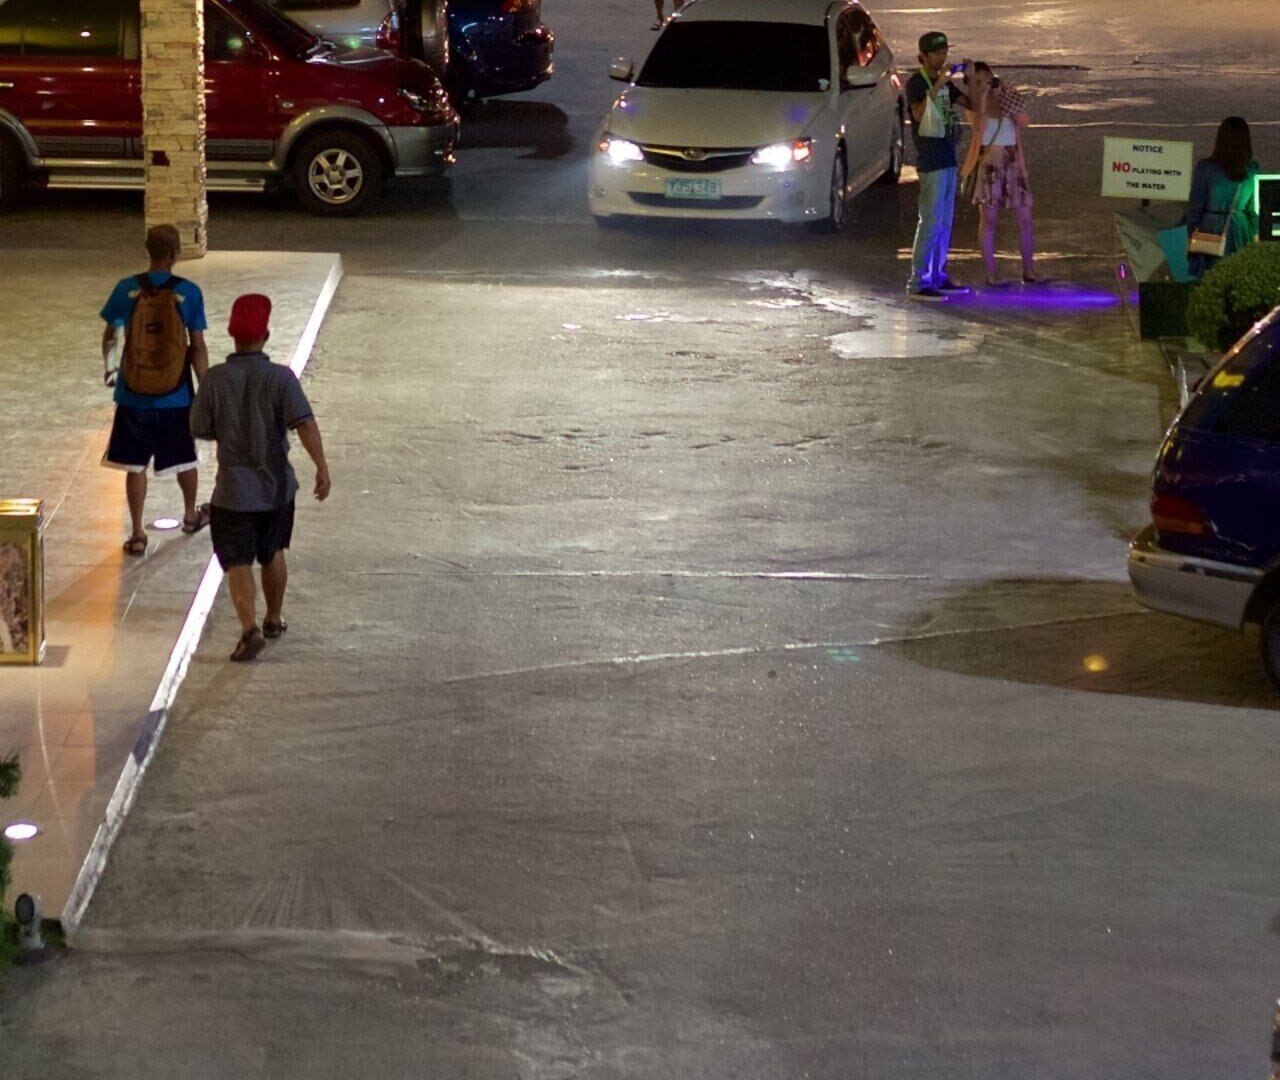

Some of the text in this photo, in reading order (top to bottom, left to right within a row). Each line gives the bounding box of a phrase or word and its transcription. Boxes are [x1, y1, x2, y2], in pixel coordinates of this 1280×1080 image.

[1132, 145, 1163, 153] NOTICE
[1112, 161, 1131, 173] NO
[1132, 167, 1162, 176] PLAYING
